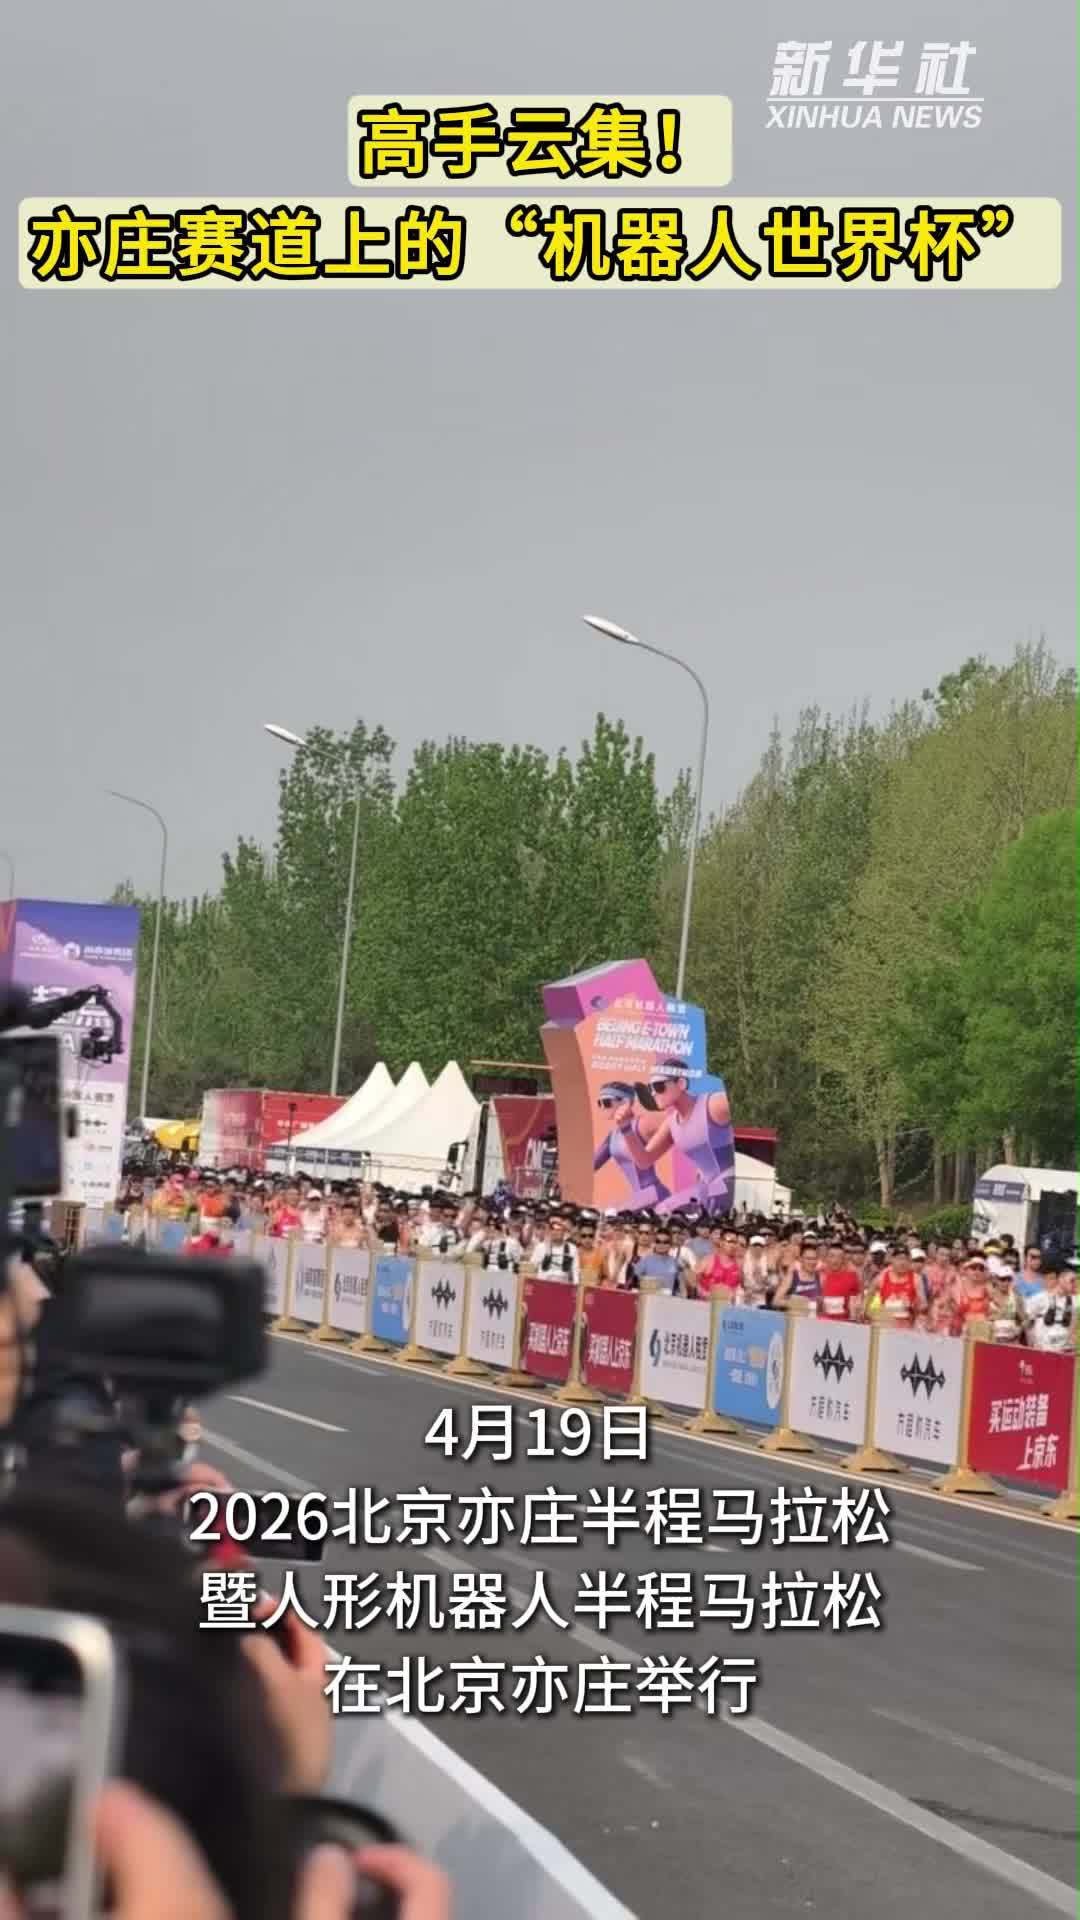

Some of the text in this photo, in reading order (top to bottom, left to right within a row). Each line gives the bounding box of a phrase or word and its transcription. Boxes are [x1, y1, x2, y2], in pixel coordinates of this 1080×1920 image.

[987, 1392, 1049, 1434] 买运动装备
[1016, 1432, 1060, 1472] 上京东
